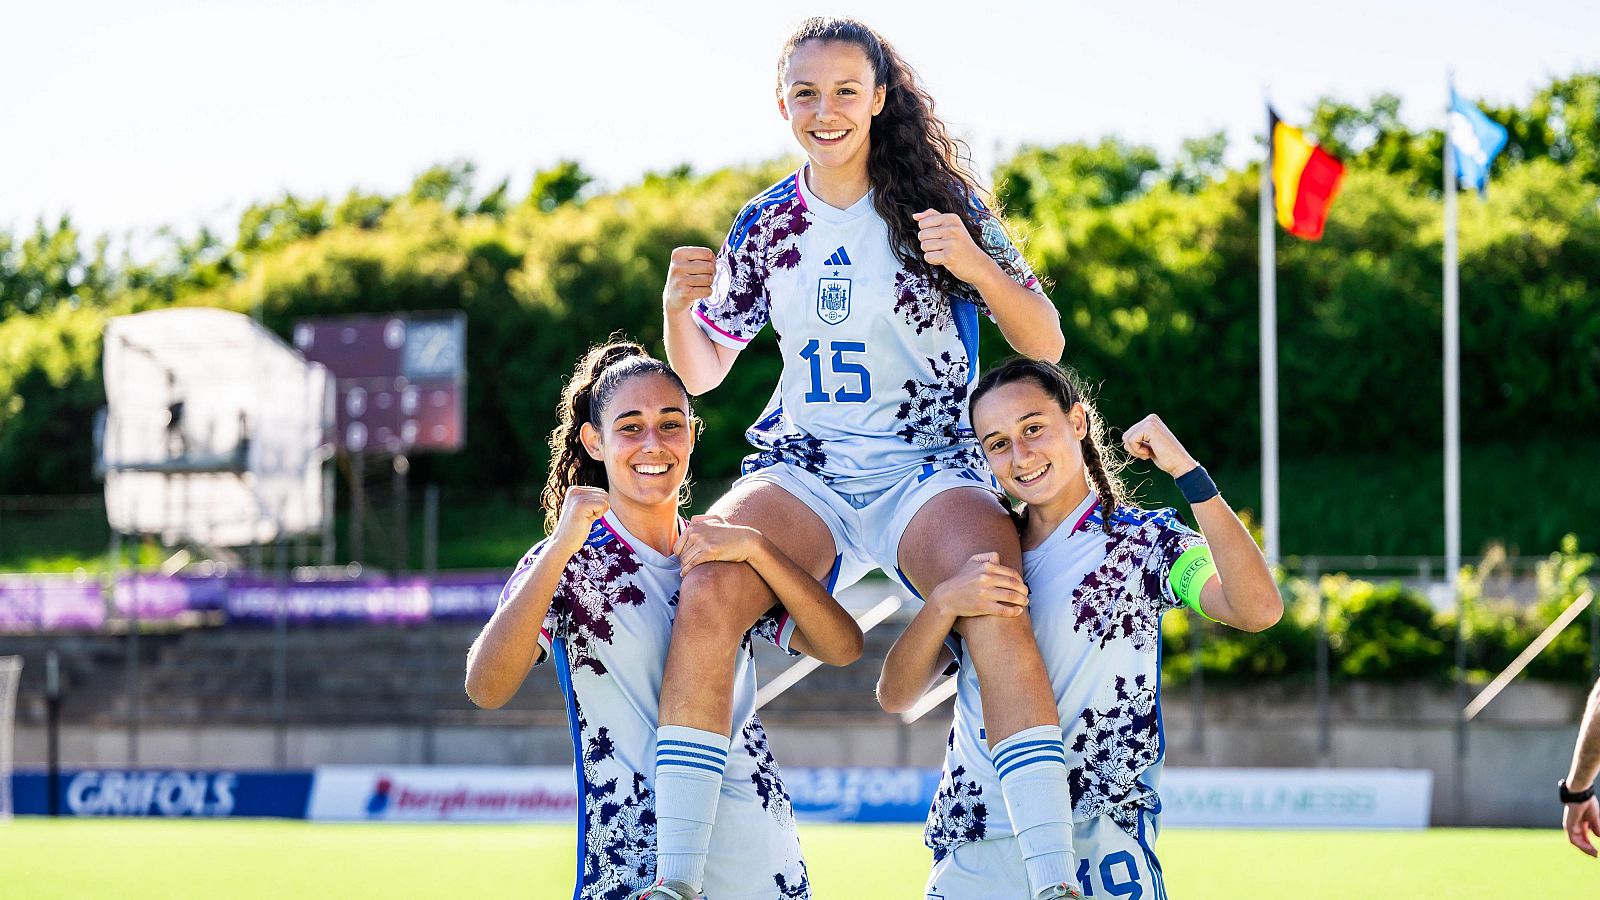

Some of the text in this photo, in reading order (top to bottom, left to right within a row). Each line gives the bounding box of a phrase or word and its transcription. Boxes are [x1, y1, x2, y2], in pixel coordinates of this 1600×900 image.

[798, 338, 872, 404] 15
[1180, 557, 1208, 596] RESPECT
[66, 772, 237, 816] GRIFOLS
[1076, 849, 1143, 900] 19
